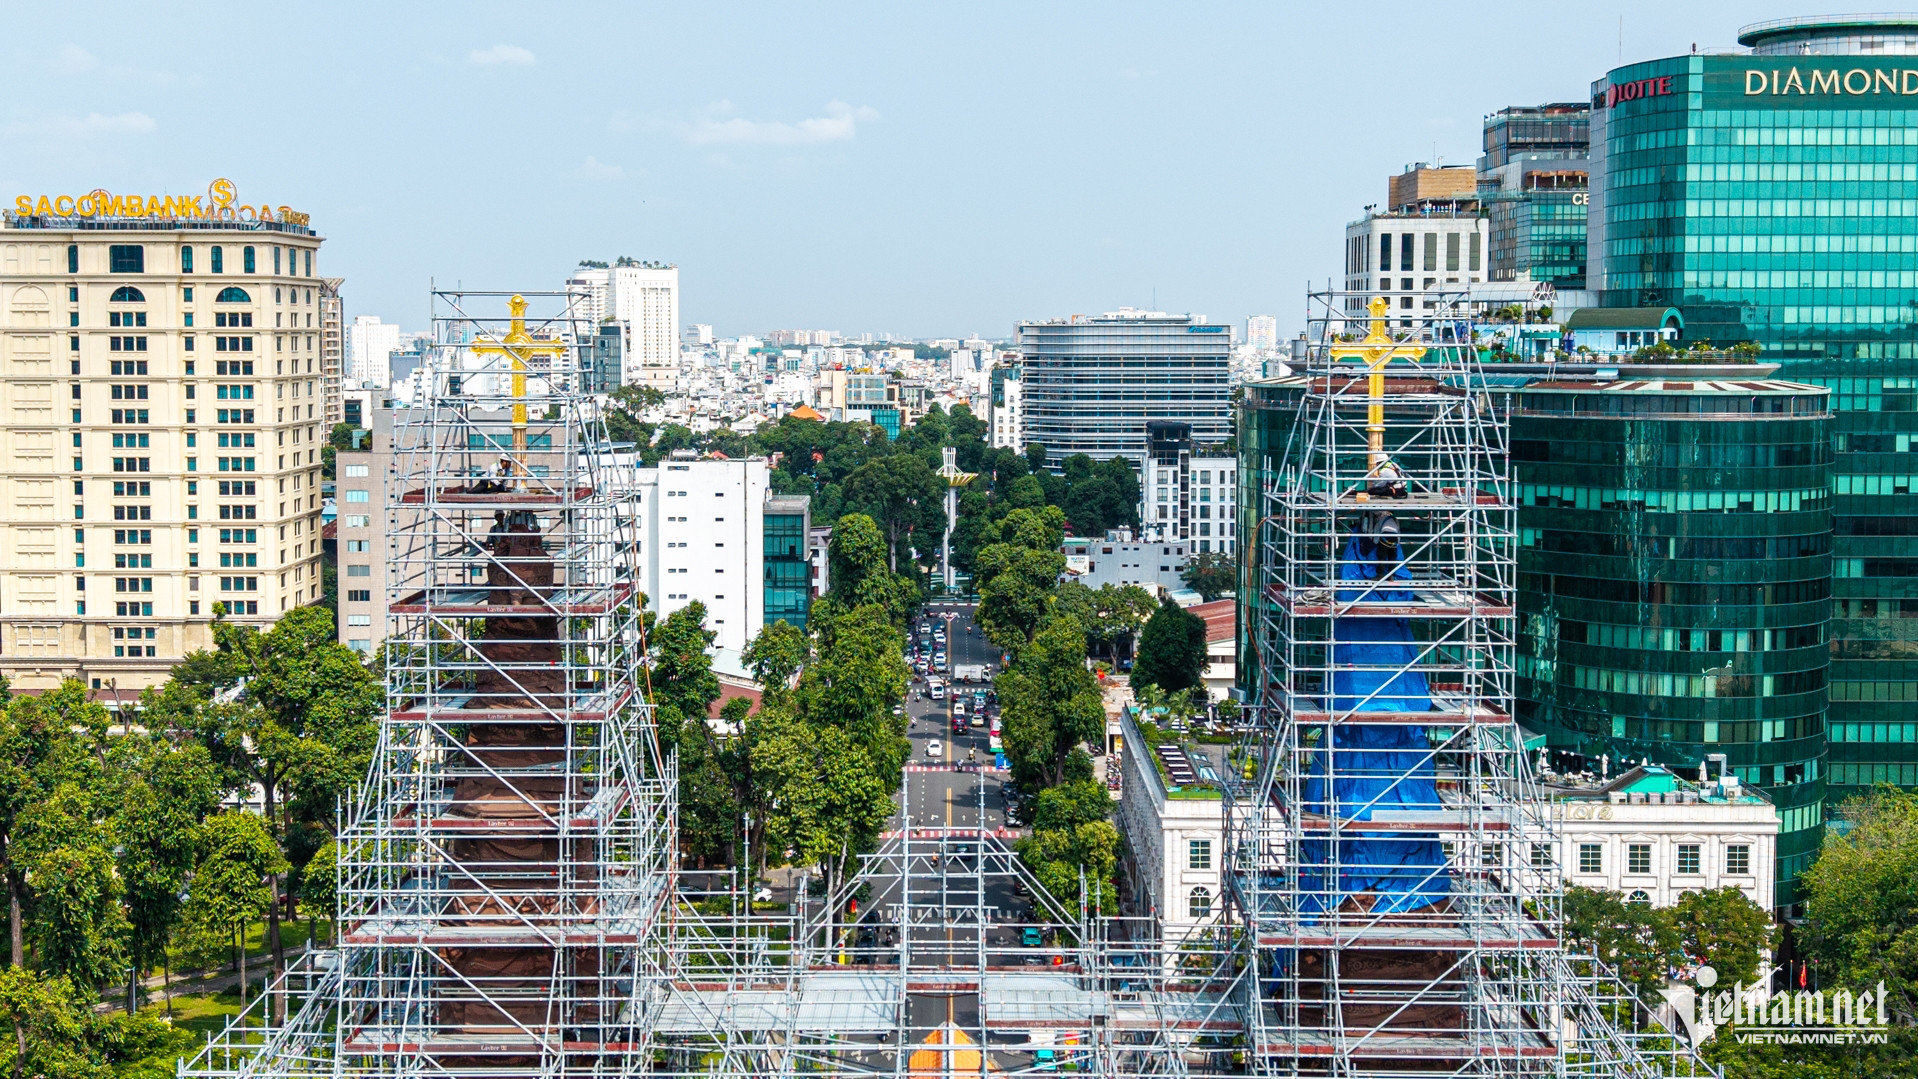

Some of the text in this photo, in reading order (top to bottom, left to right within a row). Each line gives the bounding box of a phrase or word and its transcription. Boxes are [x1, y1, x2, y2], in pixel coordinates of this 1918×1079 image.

[1617, 76, 1672, 102] LOTTE
[1744, 66, 1918, 95] DIAMOND
[15, 195, 203, 217] SACOMBANK
